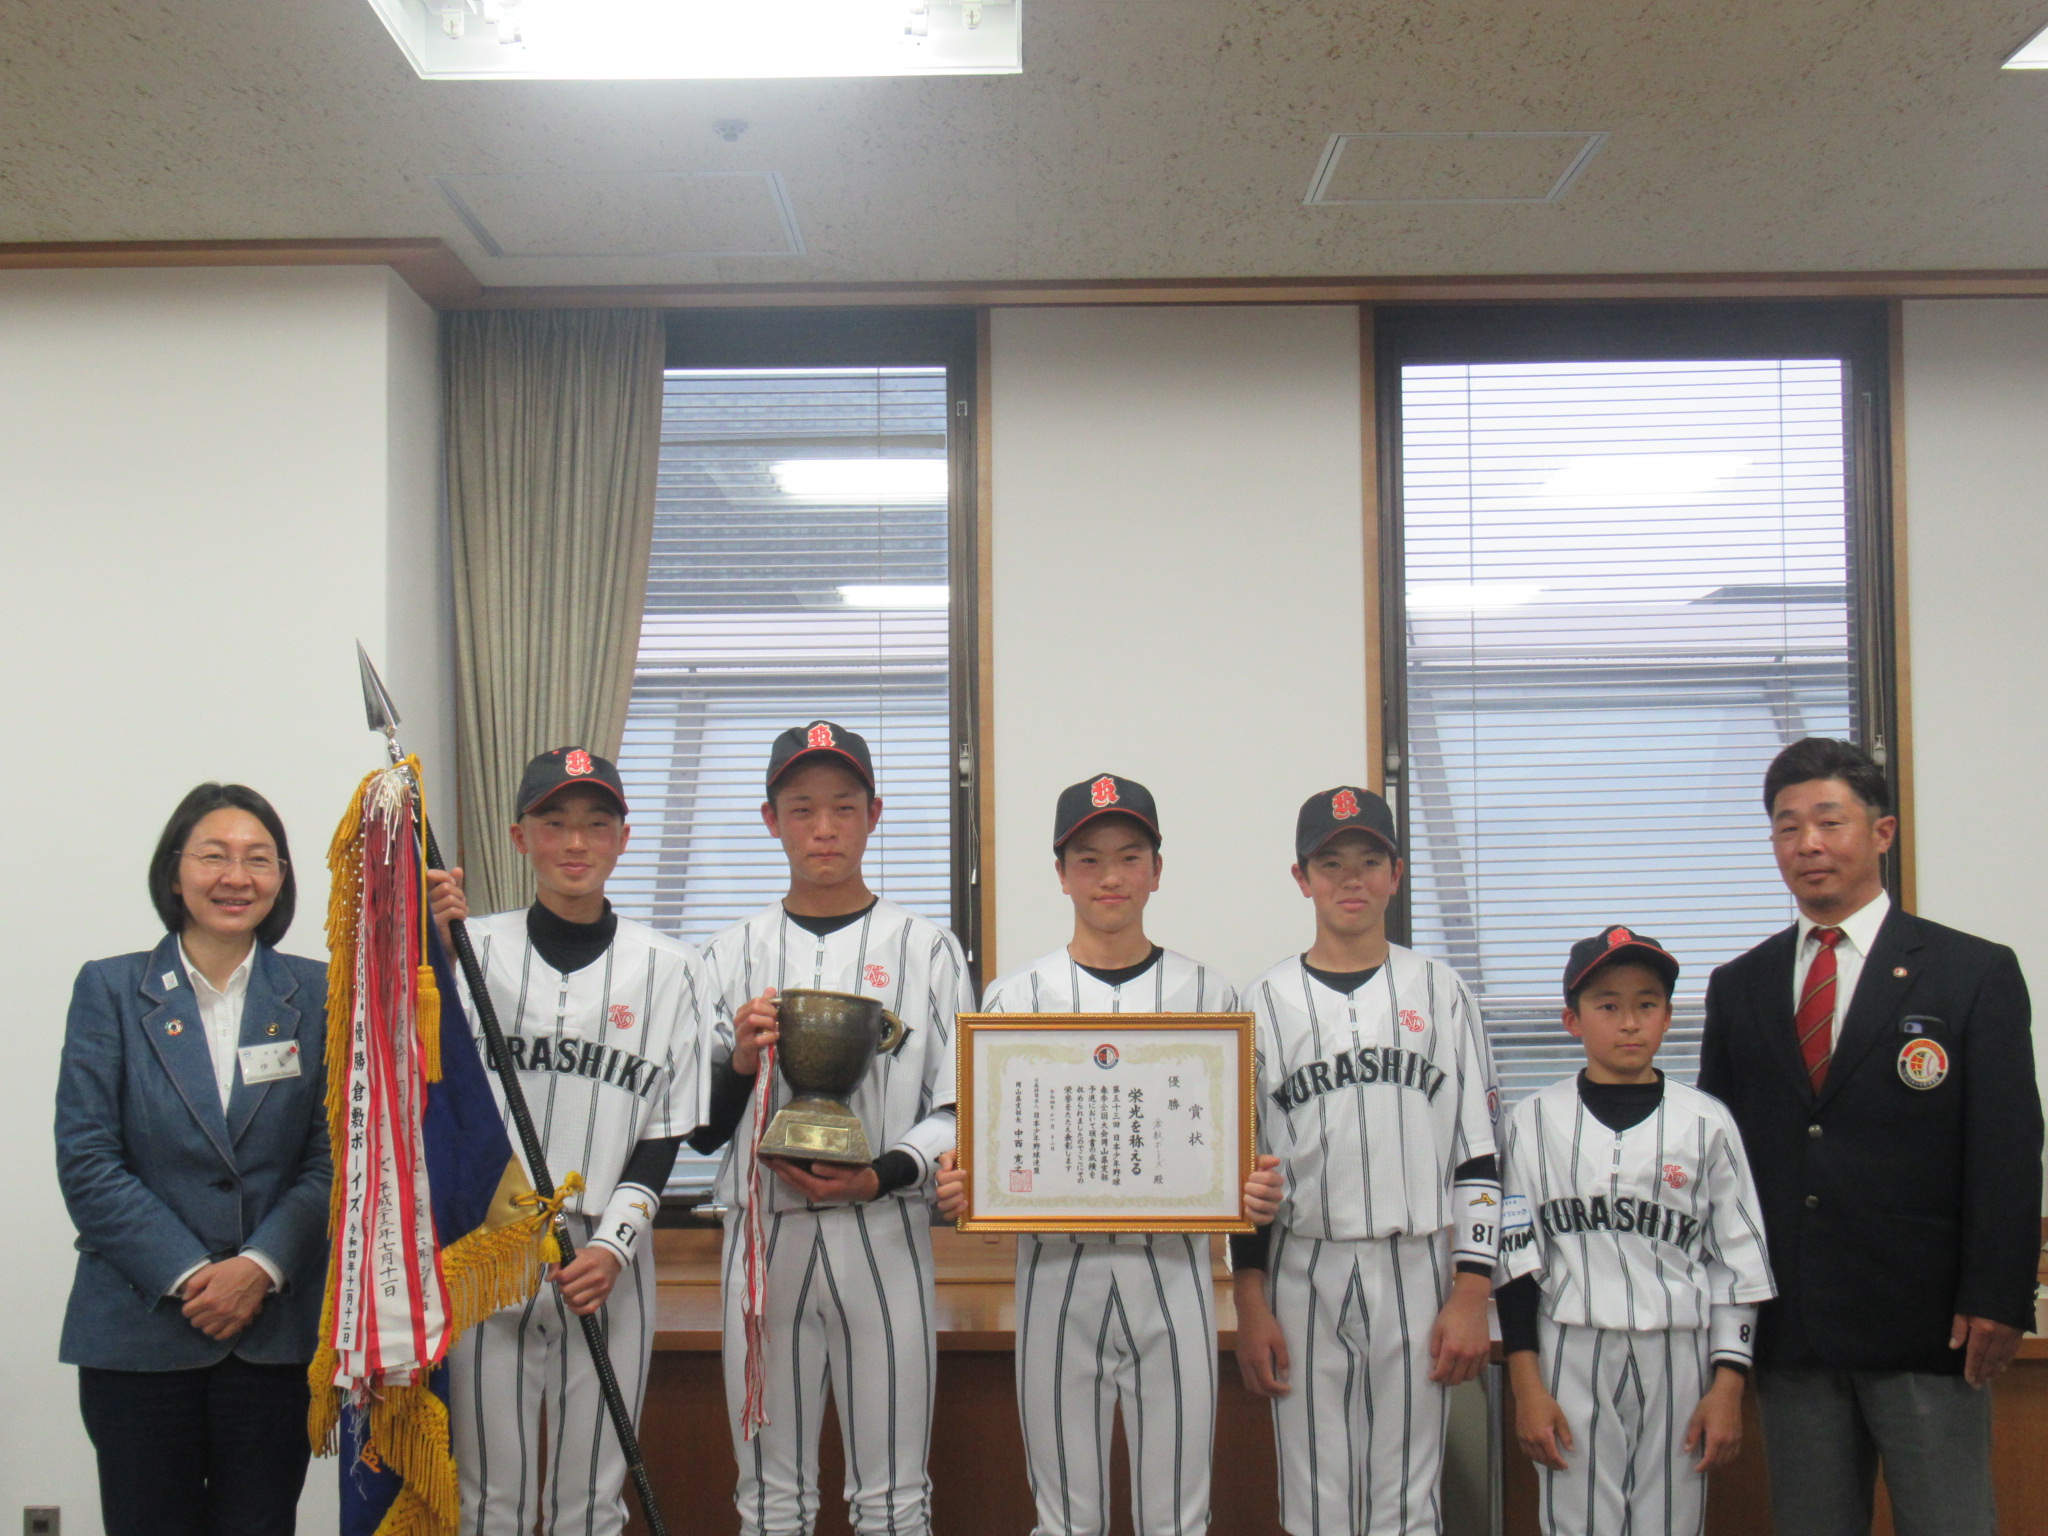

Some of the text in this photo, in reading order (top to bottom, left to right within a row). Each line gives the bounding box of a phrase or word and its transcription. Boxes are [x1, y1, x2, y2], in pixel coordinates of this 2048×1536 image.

[353, 1021, 366, 1071] 優勝
[1168, 1075, 1180, 1111] 優勝
[1268, 1045, 1449, 1116] KURASHIKI
[348, 1080, 366, 1215] 倉敷ボーイズ
[1128, 1087, 1145, 1176] 栄光を称える
[1188, 1103, 1204, 1147] 賞状
[1112, 1133, 1121, 1187] 日本少年野球
[1539, 1196, 1699, 1252] KURASHIK
[342, 1222, 357, 1344] 令和四年十一月十二日
